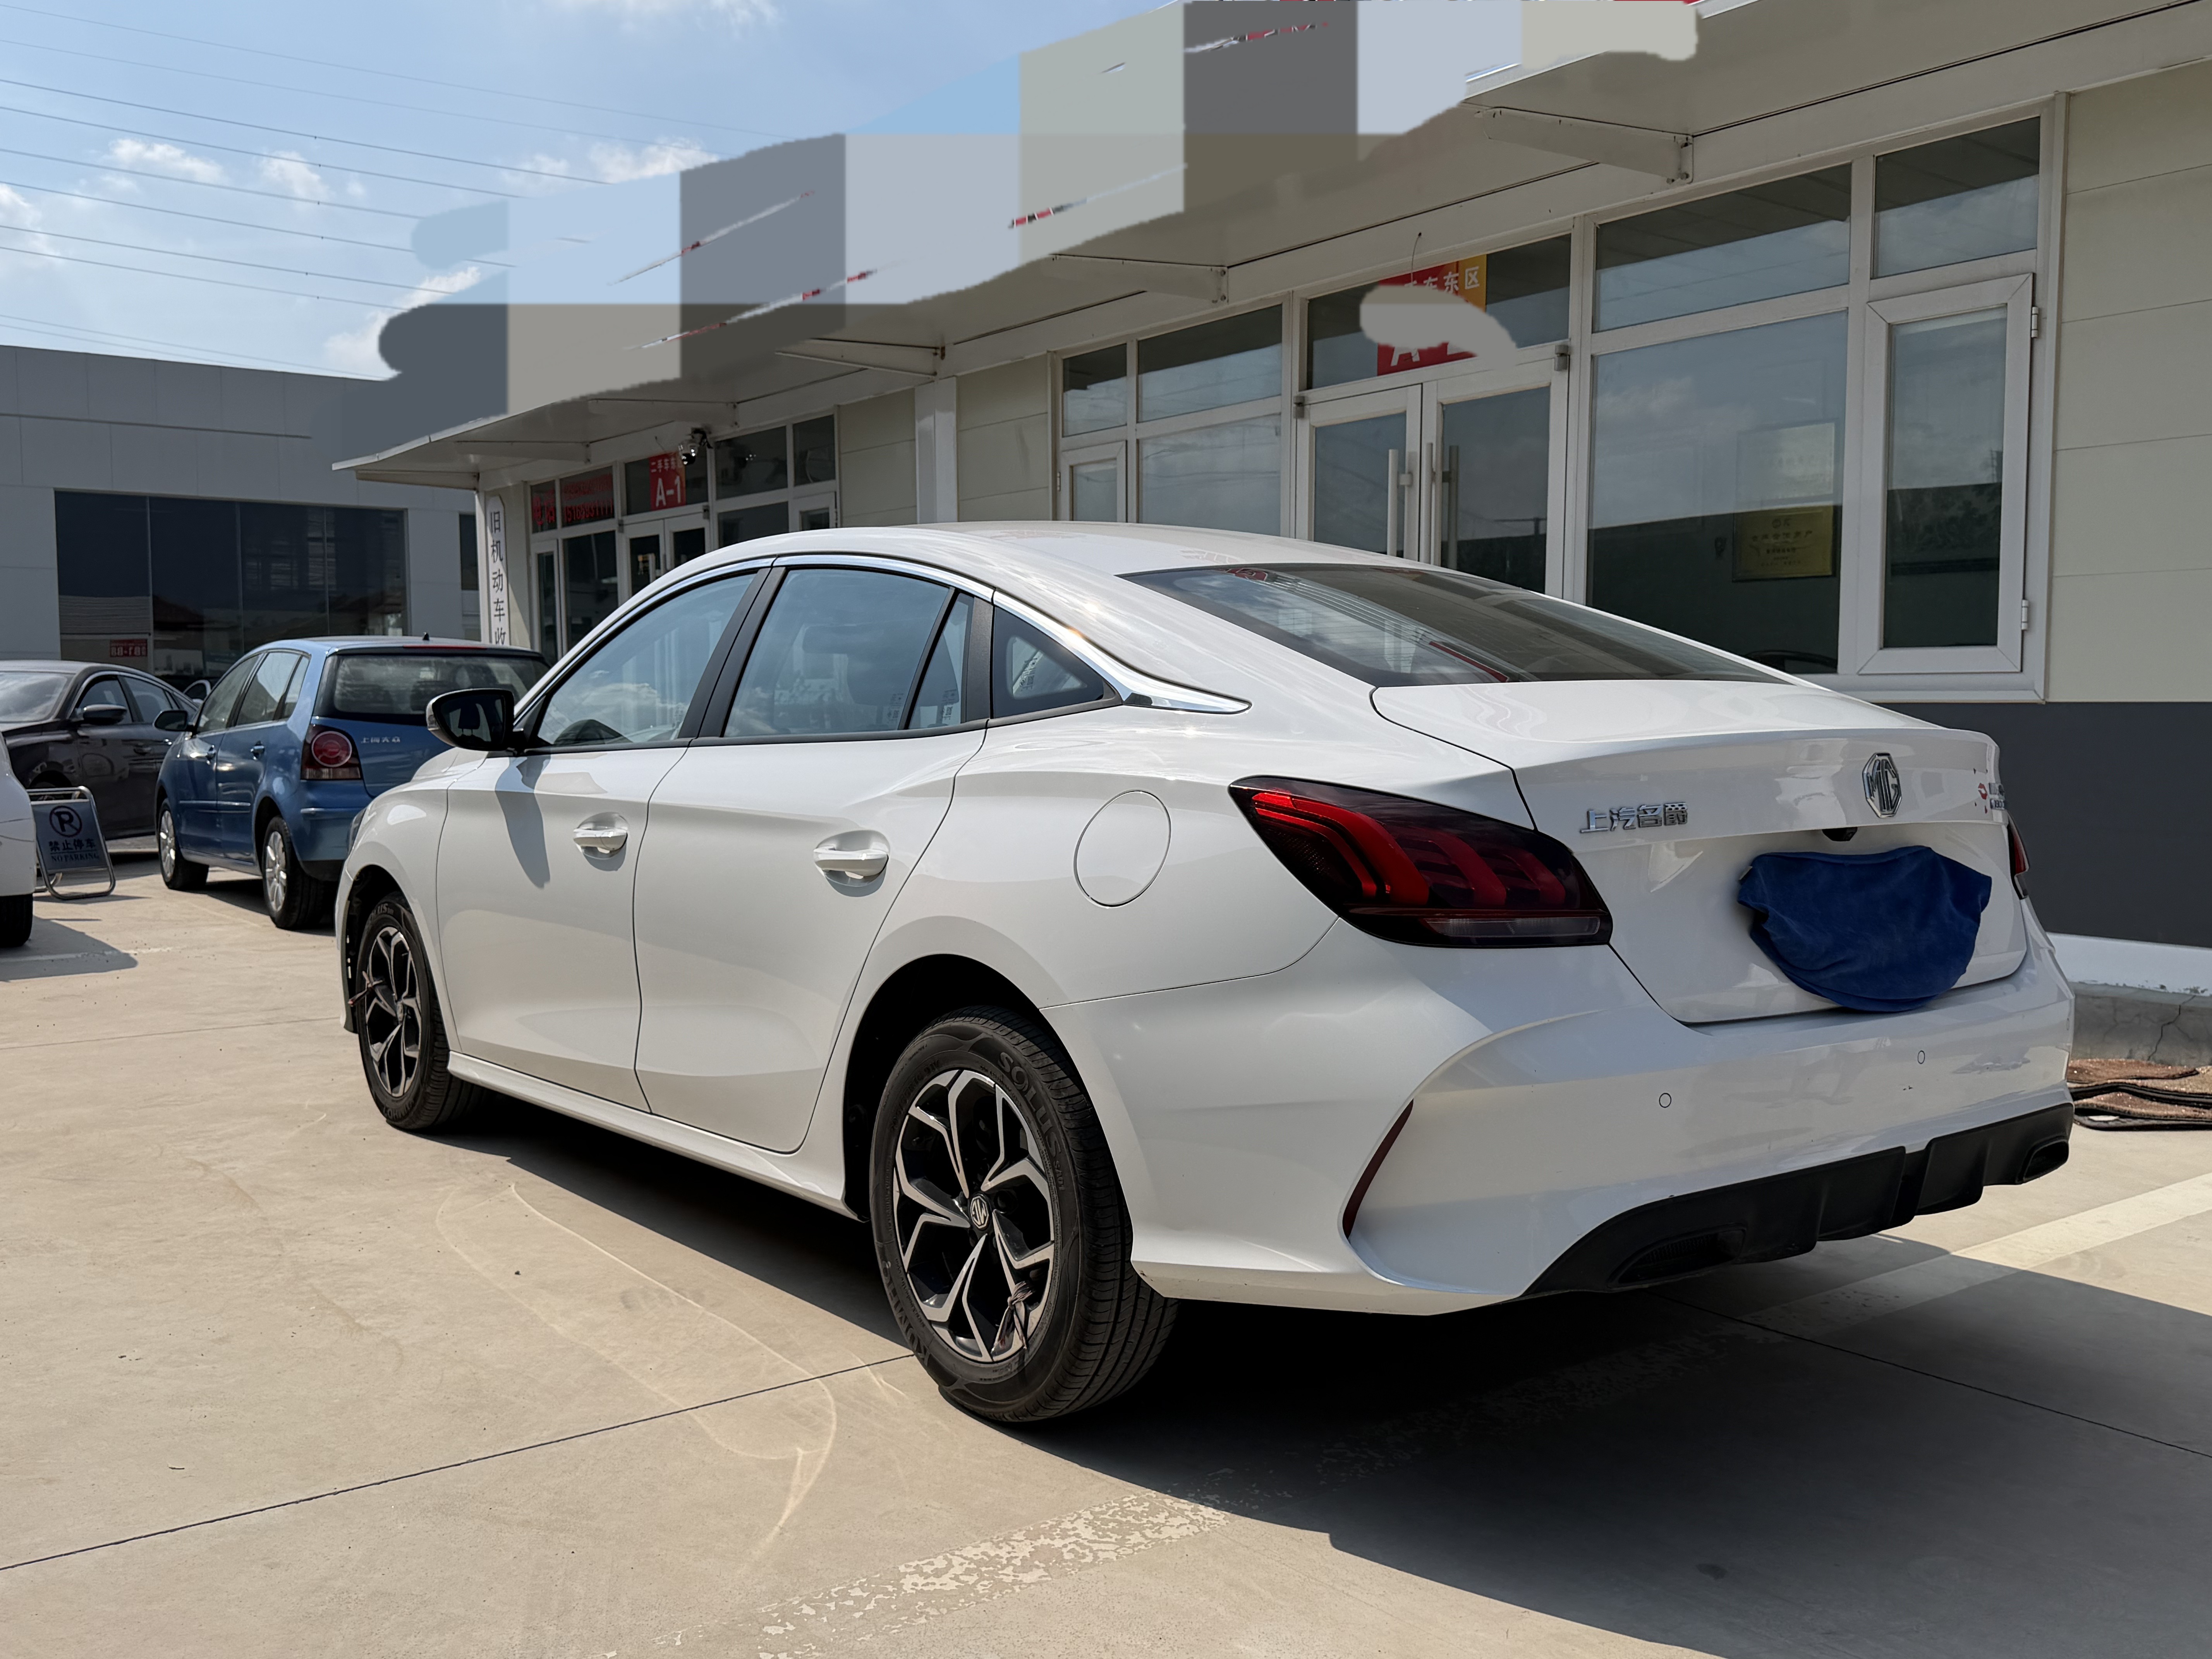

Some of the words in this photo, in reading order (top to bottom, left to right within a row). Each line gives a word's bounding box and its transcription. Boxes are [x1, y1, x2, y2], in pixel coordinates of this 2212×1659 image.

[656, 475, 681, 508] A-1
[490, 511, 506, 645] 旧机动车收
[1866, 758, 1899, 814] MG
[55, 811, 74, 832] P
[1579, 802, 1688, 834] 上汽名爵
[48, 838, 96, 852] 禁止停车
[64, 853, 100, 862] PARKING
[998, 1052, 1061, 1158] SOLUS
